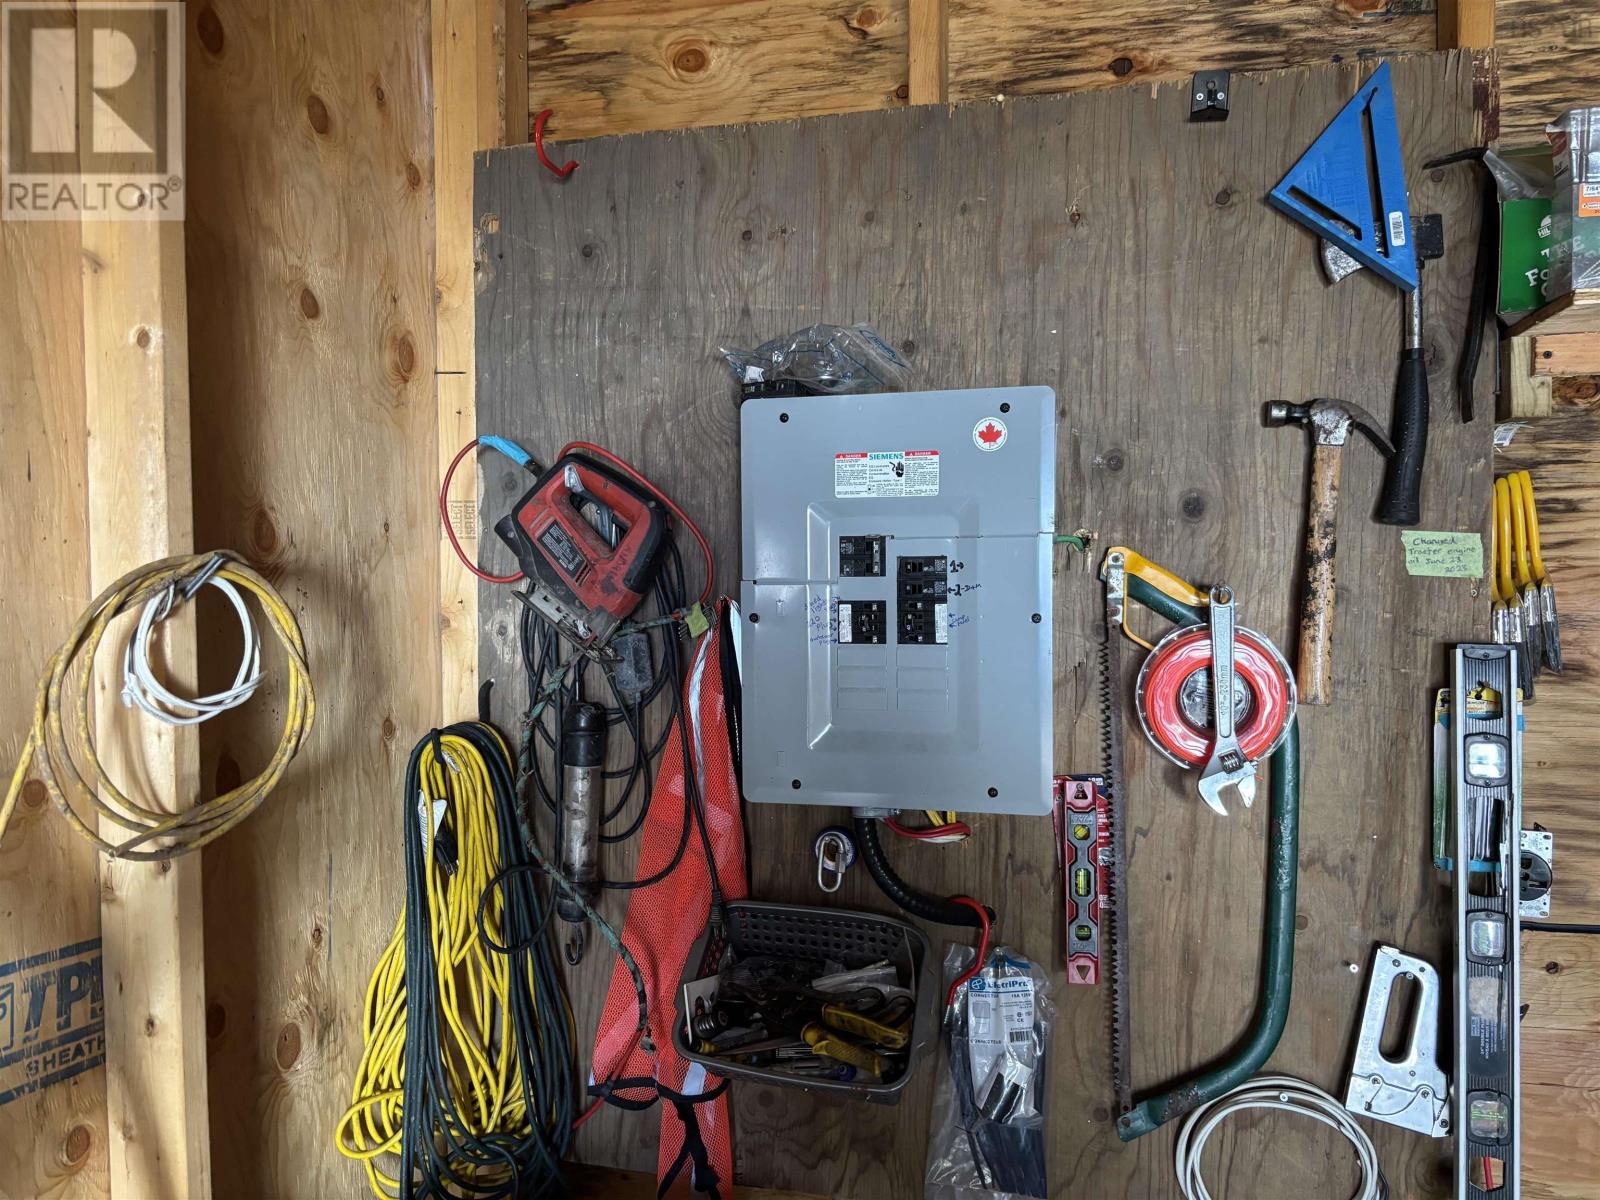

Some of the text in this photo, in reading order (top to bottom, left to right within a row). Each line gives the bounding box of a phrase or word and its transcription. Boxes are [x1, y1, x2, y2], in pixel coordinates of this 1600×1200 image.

[869, 452, 904, 460] SIEMENS
[1447, 546, 1476, 556] engine
[1425, 557, 1444, 565] June
